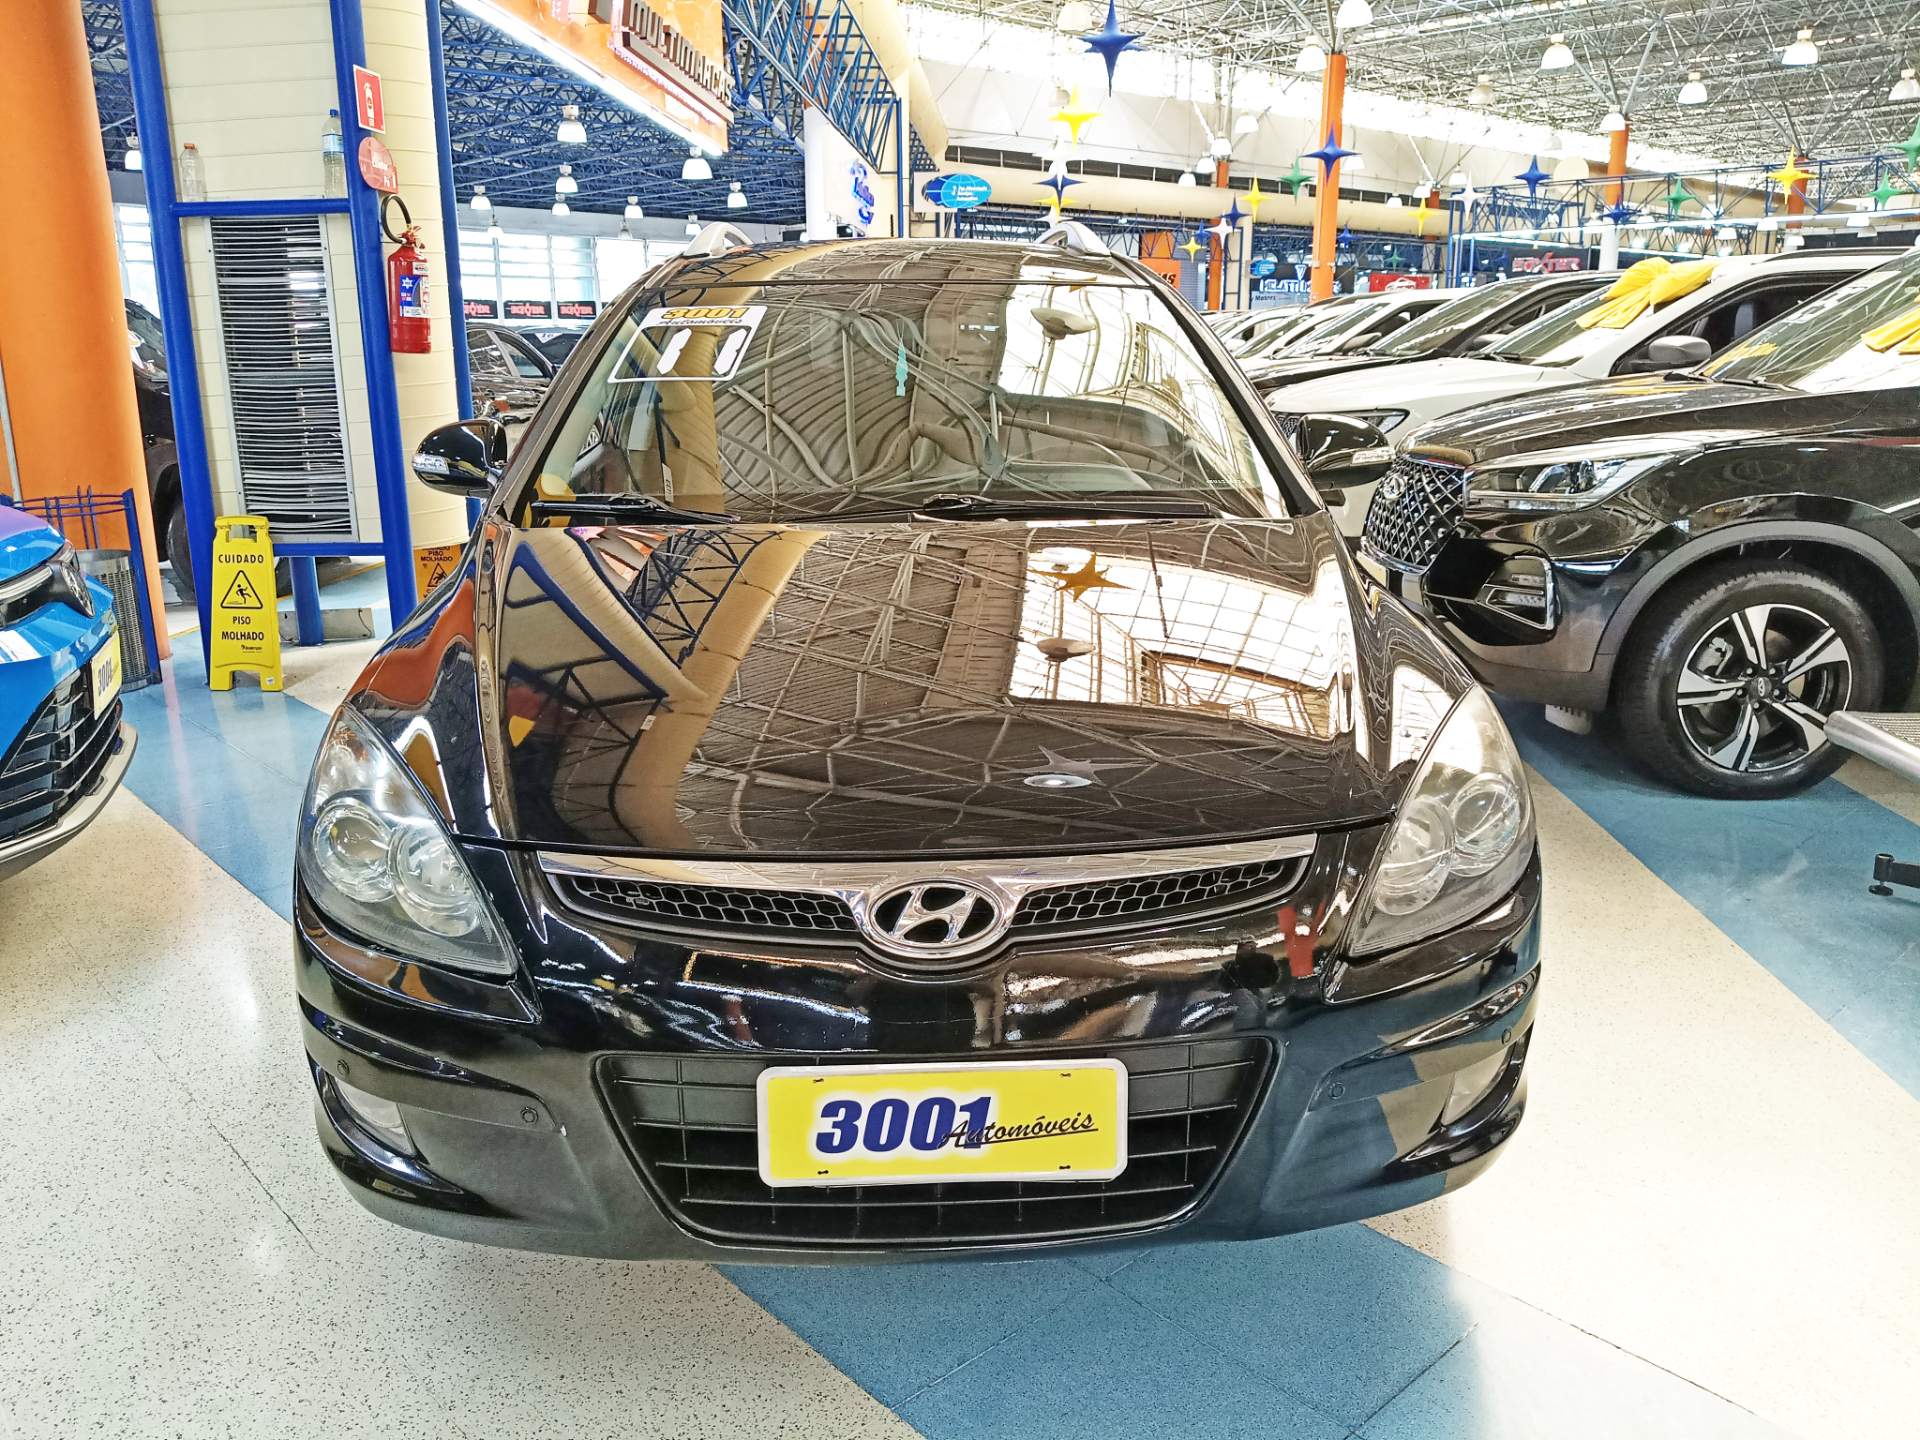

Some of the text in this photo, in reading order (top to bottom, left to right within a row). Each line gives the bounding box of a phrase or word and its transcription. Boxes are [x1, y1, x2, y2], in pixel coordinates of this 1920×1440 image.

[661, 307, 750, 320] 3001
[218, 554, 264, 563] CUIDADO
[232, 616, 251, 624] PISO
[222, 632, 264, 641] MOLHADO
[815, 1096, 1099, 1154] 3001 Automóveis
